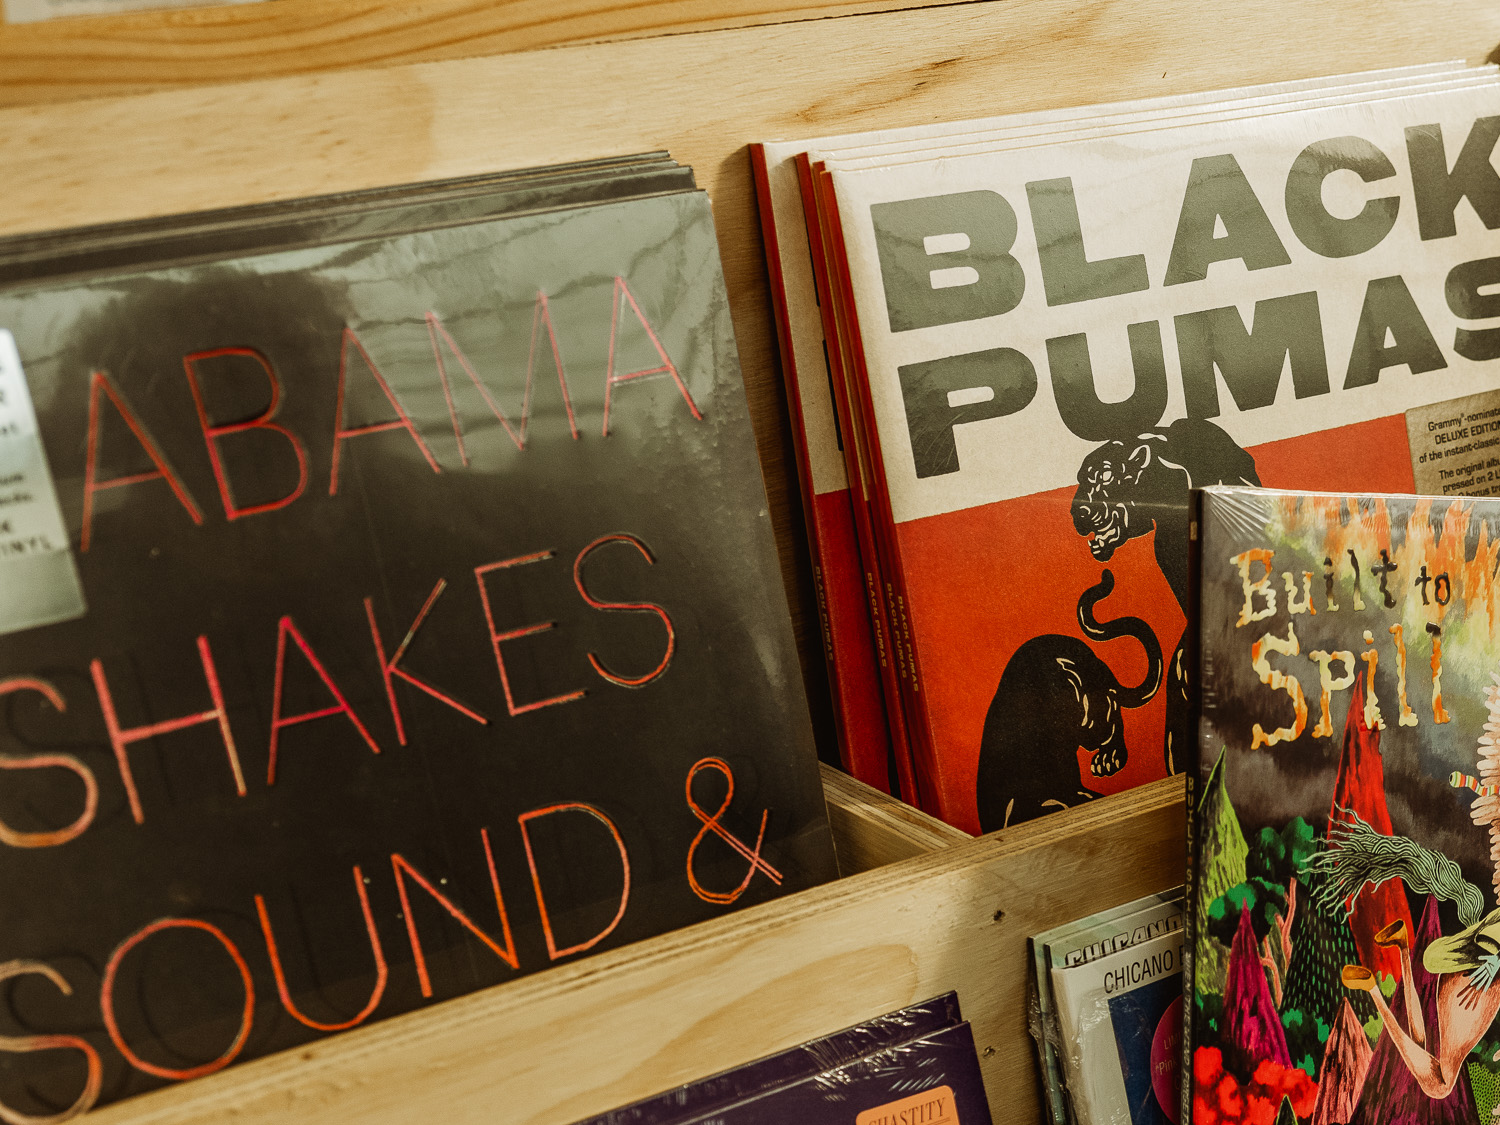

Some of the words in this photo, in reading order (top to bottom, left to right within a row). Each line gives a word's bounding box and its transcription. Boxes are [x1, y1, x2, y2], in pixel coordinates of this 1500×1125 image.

[80, 274, 705, 553] ABAMA
[1419, 453, 1428, 464] of
[1429, 450, 1442, 461] the
[1444, 436, 1500, 458] instant-classic
[1434, 427, 1469, 445] DELUXE
[1438, 469, 1454, 480] The
[1455, 460, 1484, 477] original
[1442, 478, 1474, 493] pressed
[1476, 475, 1485, 483] on
[1487, 471, 1494, 481] 2
[815, 566, 826, 609] BLACK
[823, 613, 833, 661] PUMAS
[867, 572, 878, 616] BLACK
[875, 619, 887, 668] PUMAS
[886, 582, 898, 627] BLACK
[895, 630, 907, 679] PUMAS
[1230, 548, 1398, 629] Built
[1414, 565, 1450, 606] to
[0, 532, 676, 848] SHAKES
[898, 596, 909, 639] BLACK
[906, 643, 919, 692] PUMAS
[1251, 621, 1451, 750] Spill
[685, 757, 784, 906] &
[1104, 949, 1174, 994] CHICANO
